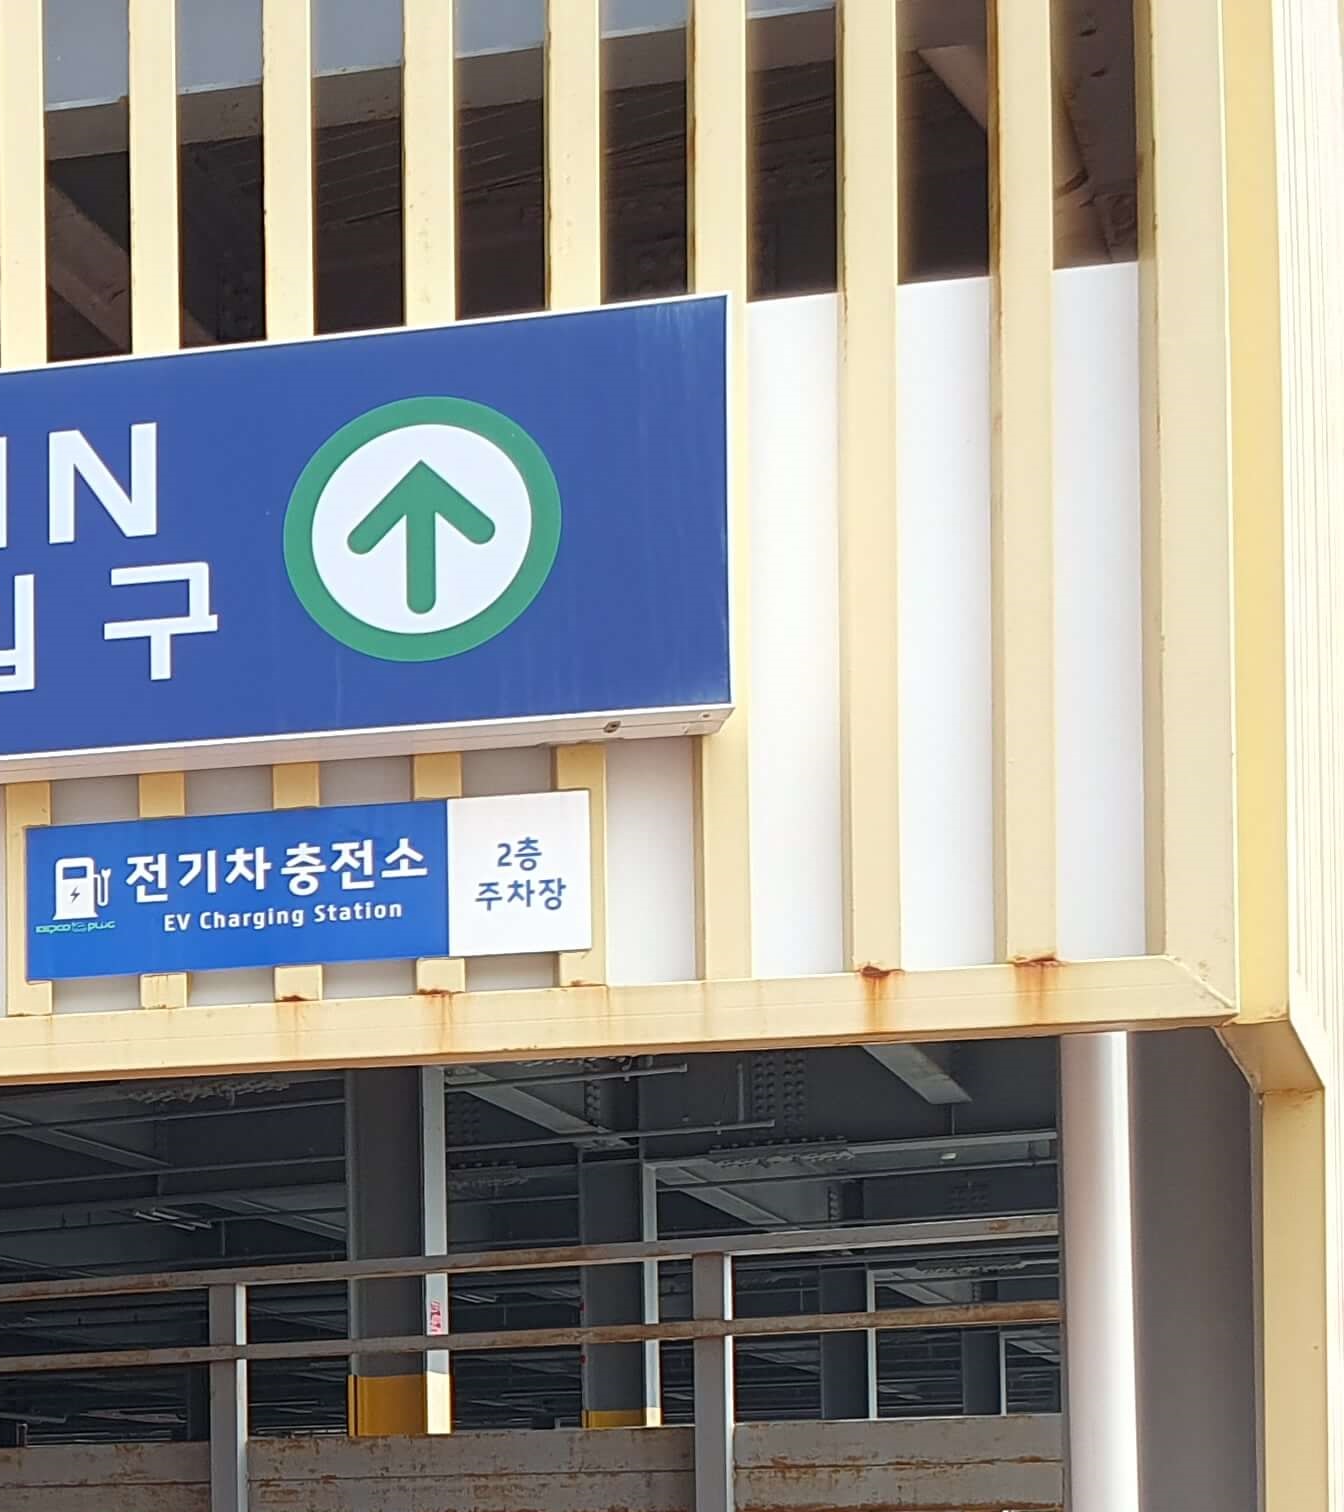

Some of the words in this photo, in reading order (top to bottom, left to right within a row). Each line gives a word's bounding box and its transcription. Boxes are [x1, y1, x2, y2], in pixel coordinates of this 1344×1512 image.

[496, 837, 544, 870] 2층
[125, 845, 272, 906] 전기차
[280, 838, 429, 898] 충전소
[474, 877, 567, 913] 주차장
[164, 913, 192, 933] EV
[199, 906, 305, 932] Charging
[313, 900, 403, 924] Station
